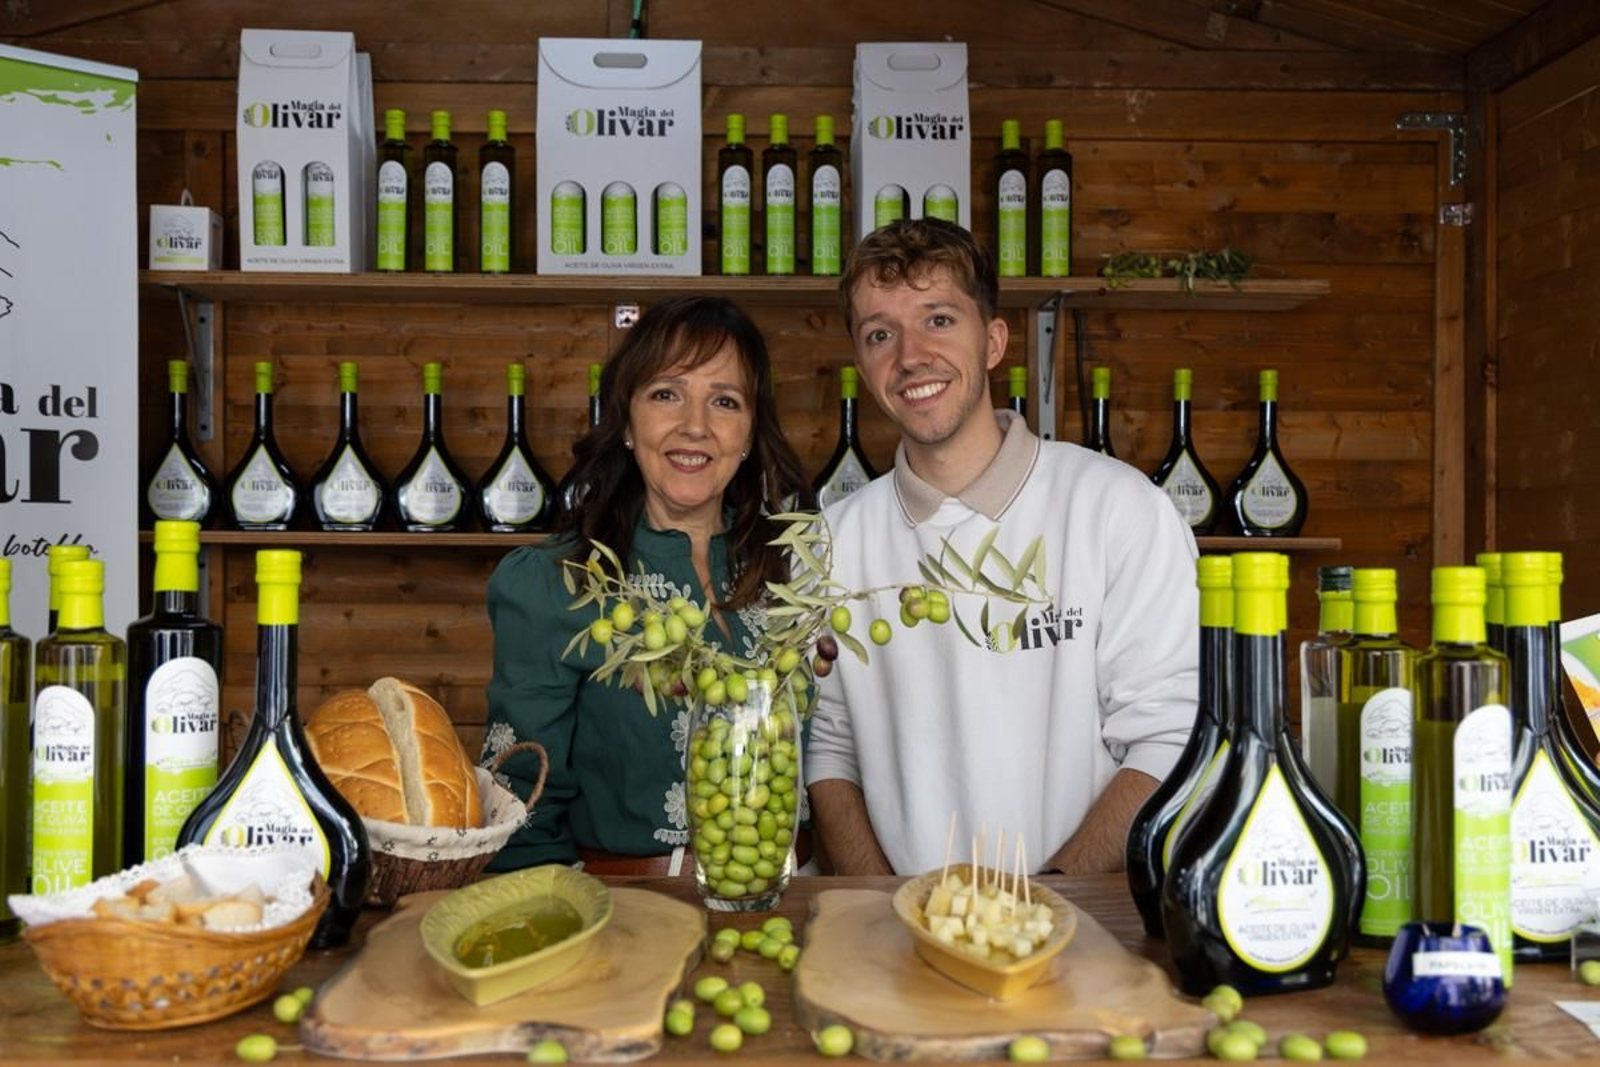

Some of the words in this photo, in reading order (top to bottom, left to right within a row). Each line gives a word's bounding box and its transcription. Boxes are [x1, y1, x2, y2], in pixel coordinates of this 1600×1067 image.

[245, 103, 341, 128] Olivar
[291, 101, 324, 112] Magia
[618, 106, 656, 119] Magia
[660, 109, 674, 117] del
[567, 109, 674, 136] Olivar
[869, 116, 963, 139] Olivar
[914, 113, 947, 124] Magia
[38, 384, 99, 418] del
[1067, 608, 1082, 617] del
[987, 618, 1083, 653] Olivr
[151, 714, 217, 734] Olivar
[266, 824, 297, 834] Magia
[1238, 861, 1318, 886] Olivar
